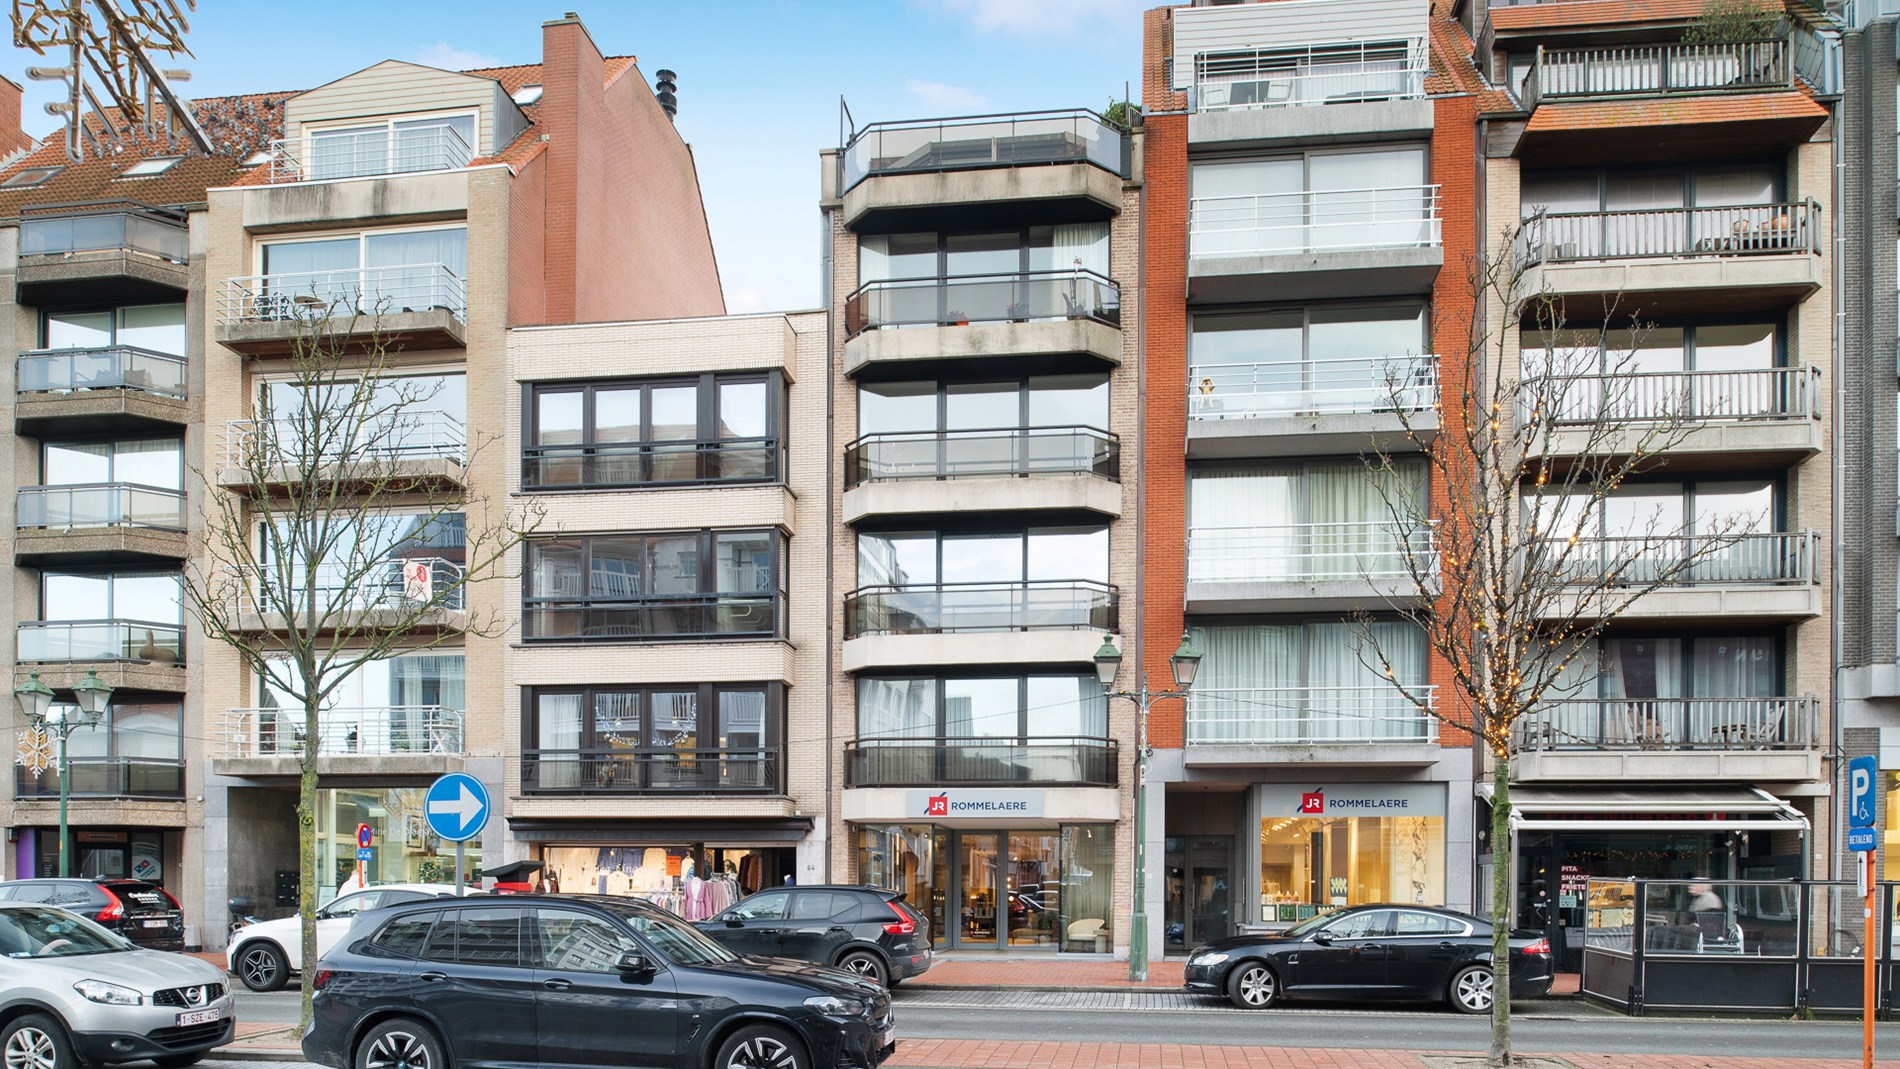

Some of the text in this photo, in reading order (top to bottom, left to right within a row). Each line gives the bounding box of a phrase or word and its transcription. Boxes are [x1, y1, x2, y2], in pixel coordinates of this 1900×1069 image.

[1852, 768, 1870, 817] P
[932, 802, 945, 811] JR
[951, 802, 1027, 810] ROMMELAERE
[1305, 798, 1320, 808] JR
[1329, 799, 1408, 808] ROMMELAERE
[1849, 834, 1873, 845] BETALEND
